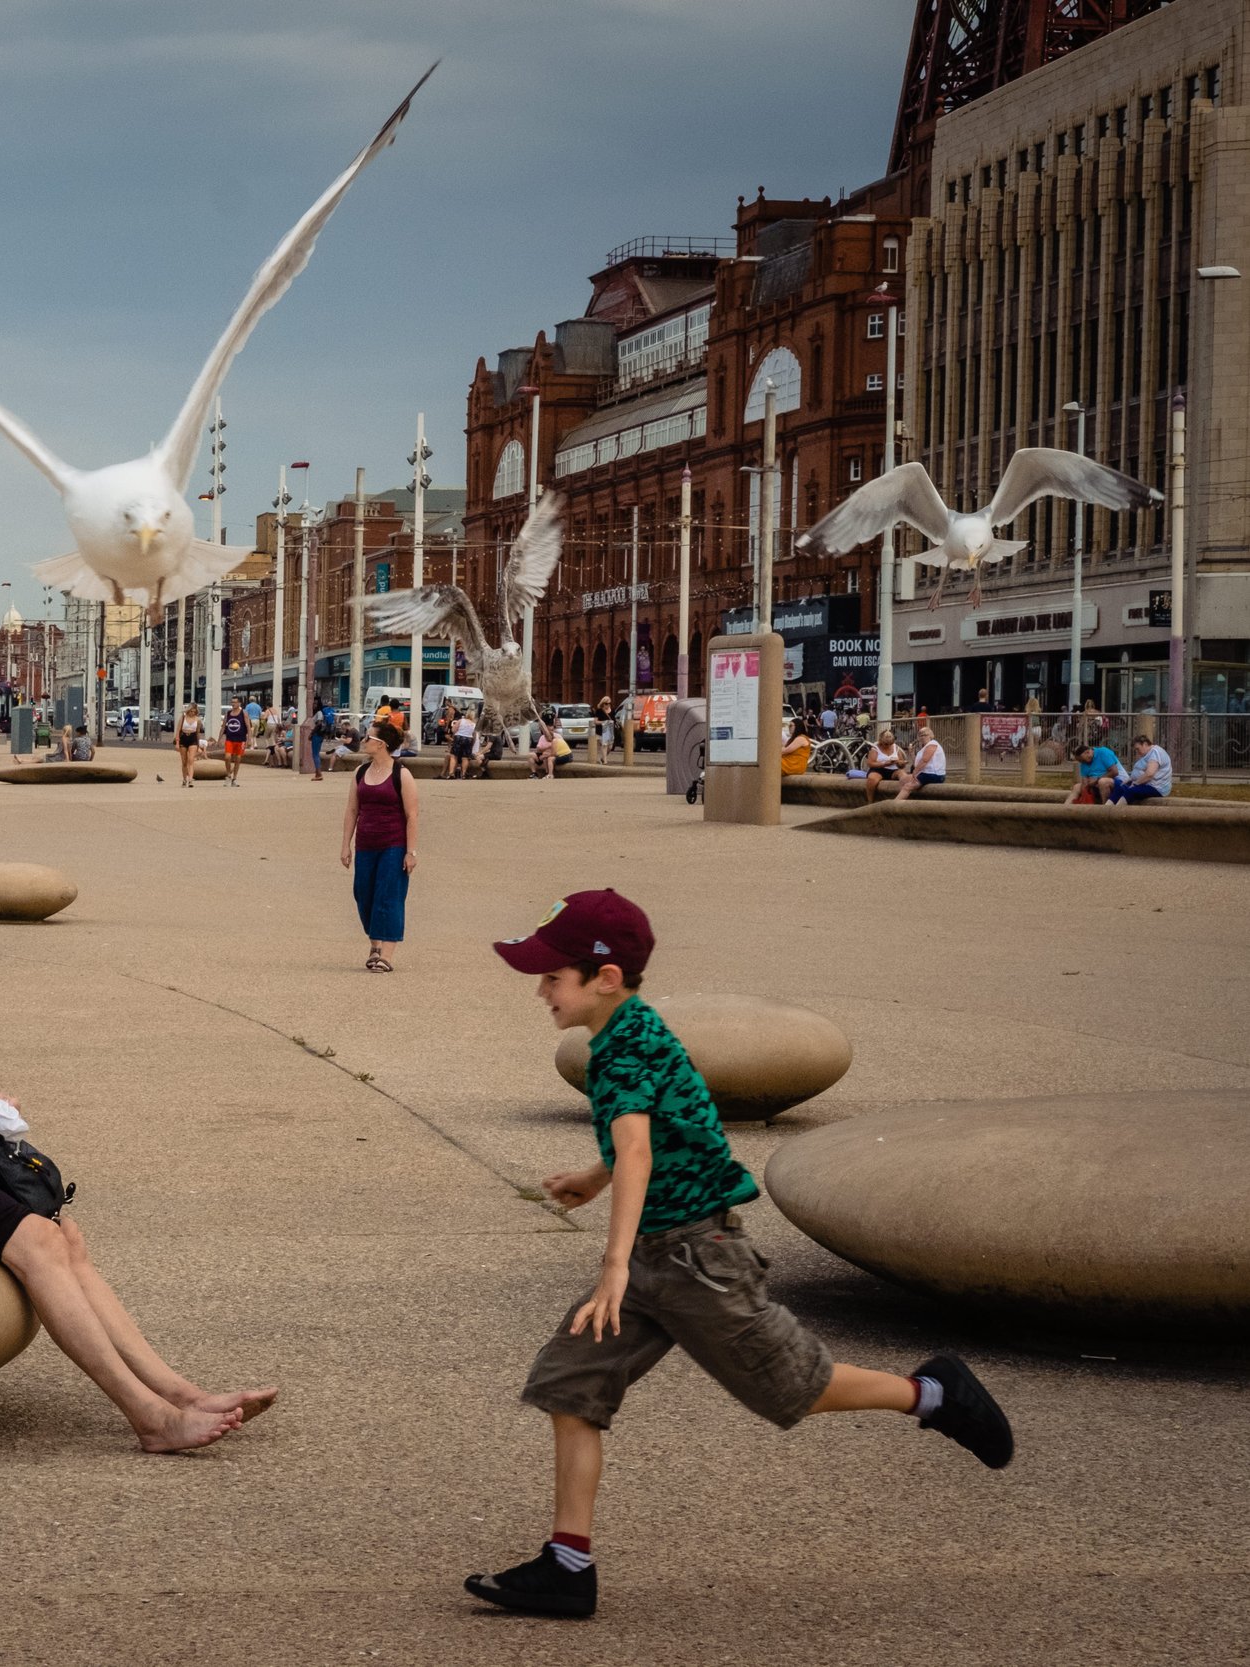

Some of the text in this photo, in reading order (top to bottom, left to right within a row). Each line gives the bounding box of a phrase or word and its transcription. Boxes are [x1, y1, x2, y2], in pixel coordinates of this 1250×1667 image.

[829, 639, 881, 652] BOOK NO
[833, 655, 848, 667] CAN
[849, 655, 863, 667] YOU
